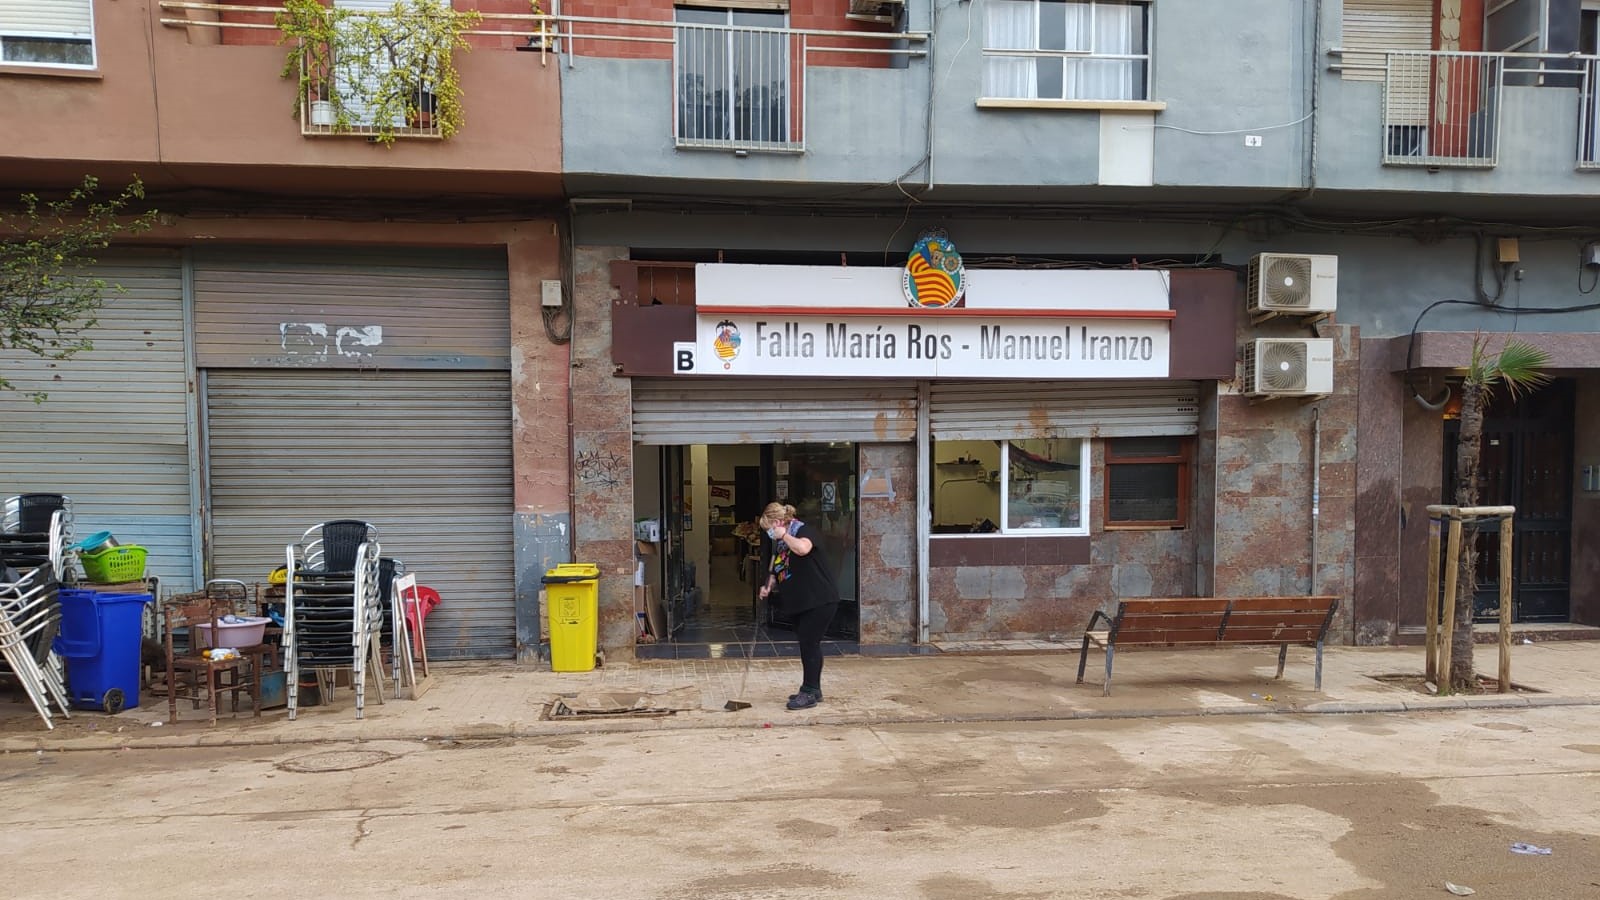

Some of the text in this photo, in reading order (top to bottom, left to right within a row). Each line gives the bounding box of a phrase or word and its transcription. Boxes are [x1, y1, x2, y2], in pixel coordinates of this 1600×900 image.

[756, 321, 814, 358] Falla
[826, 322, 896, 359] María
[907, 323, 952, 360] Ros
[980, 324, 1070, 361] Manuel
[1081, 325, 1153, 361] Iranzo
[677, 350, 694, 371] B
